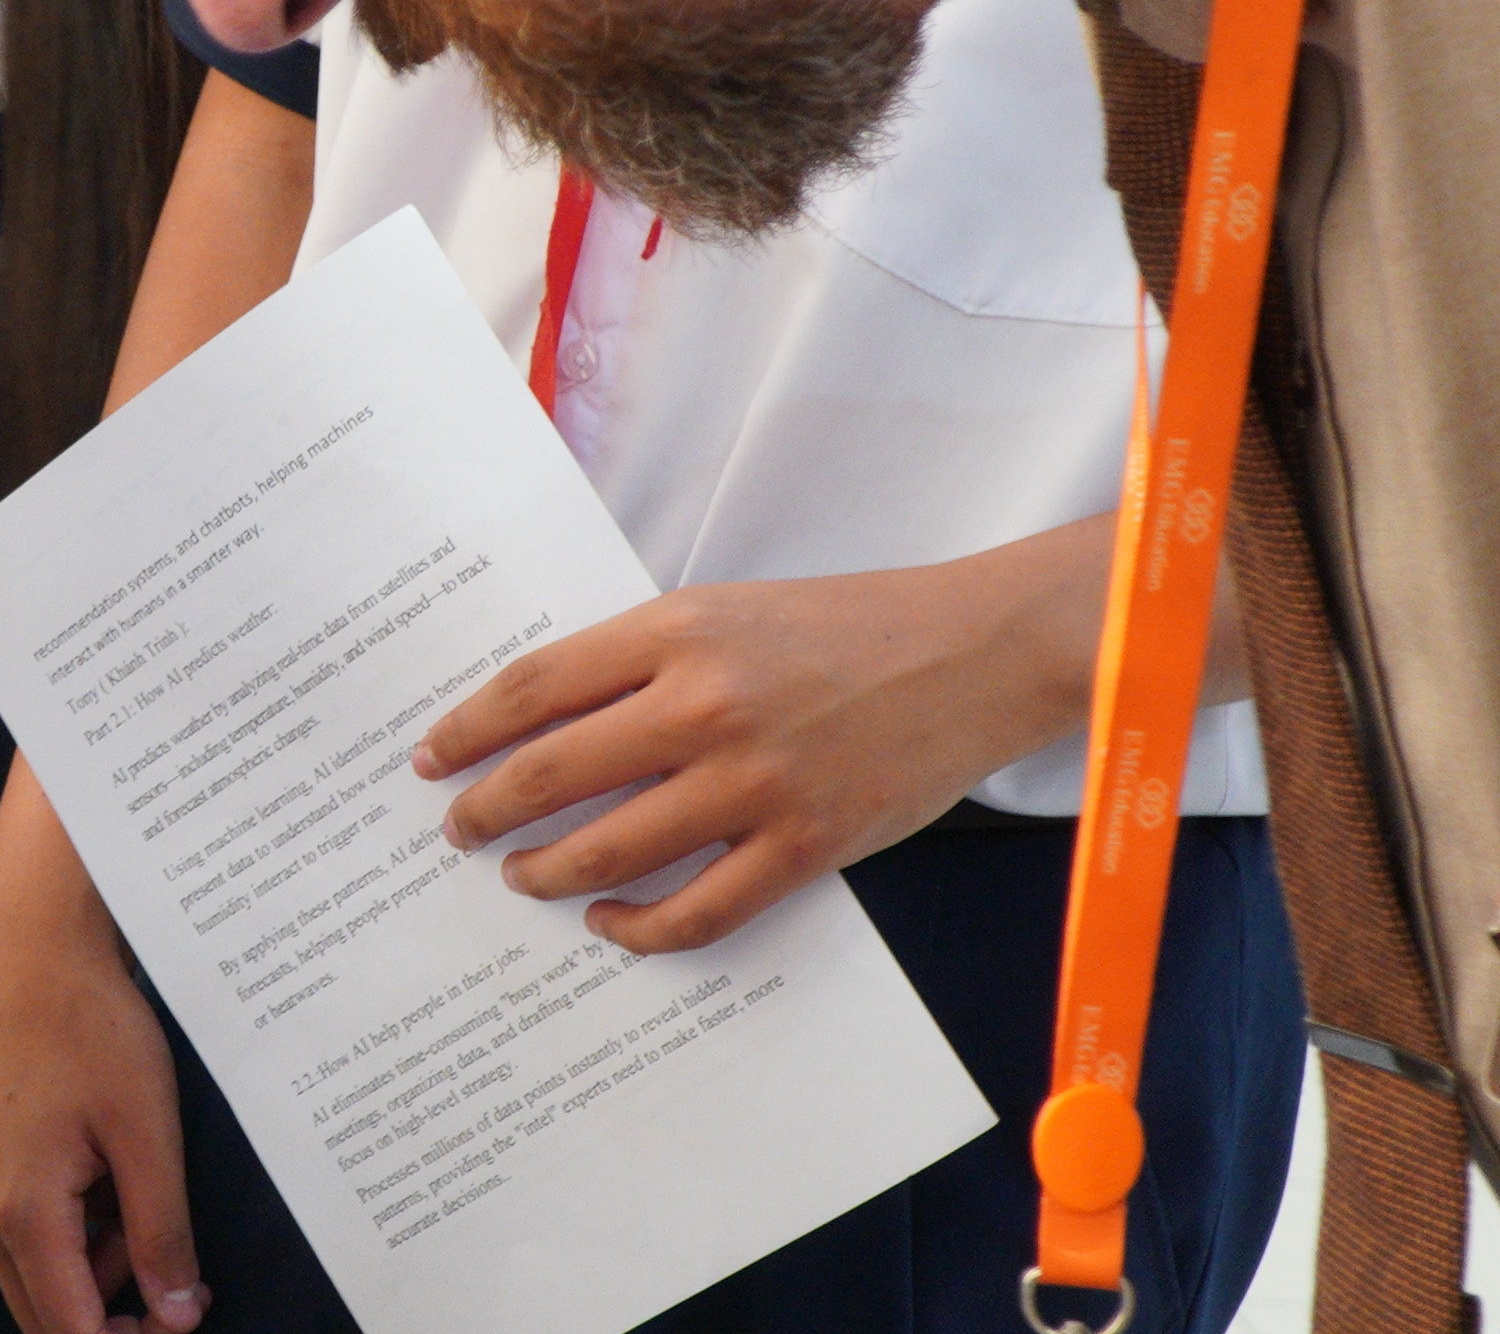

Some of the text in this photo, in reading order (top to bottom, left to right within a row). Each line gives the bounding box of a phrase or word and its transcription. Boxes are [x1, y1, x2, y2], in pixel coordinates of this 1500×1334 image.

[1193, 130, 1236, 293] EMG Education
[32, 586, 129, 663] recommendation
[174, 528, 201, 557] and
[254, 452, 310, 496] helping
[306, 405, 375, 459] machines
[48, 645, 96, 686] interact
[92, 626, 121, 652] with
[116, 594, 166, 633] humans
[162, 584, 179, 600] in
[176, 577, 188, 591] a
[185, 542, 233, 585] smarter
[342, 638, 367, 665] and
[363, 616, 397, 648] wind
[455, 553, 493, 585] track
[64, 687, 100, 715] Tony
[142, 628, 180, 658] Trinh
[82, 721, 113, 747] Part
[133, 683, 166, 711] How
[166, 667, 184, 690] AI
[181, 638, 229, 682] predicts
[112, 535, 457, 789] AI predicts weather by analyzing real-time data from satellites and
[162, 850, 206, 882] Using
[203, 815, 259, 858] machine
[313, 761, 333, 785] AI
[328, 727, 388, 771] identifies
[385, 693, 436, 738] patterns
[431, 657, 491, 700] between
[489, 634, 523, 667] past
[522, 611, 553, 641] and
[352, 1036, 371, 1061] AI
[367, 1022, 401, 1049] help
[399, 994, 447, 1034] people
[443, 984, 463, 1001] in
[460, 962, 495, 991] their
[354, 974, 733, 1205] Processes millions of data points instantly to reveal hidden
[427, 1148, 496, 1198] providing
[491, 1134, 517, 1156] the
[512, 1103, 556, 1138] "intel"
[561, 1078, 613, 1114] experts
[610, 1053, 646, 1085] need
[643, 1049, 661, 1066] to
[659, 1026, 699, 1056] make
[742, 974, 785, 1007] more
